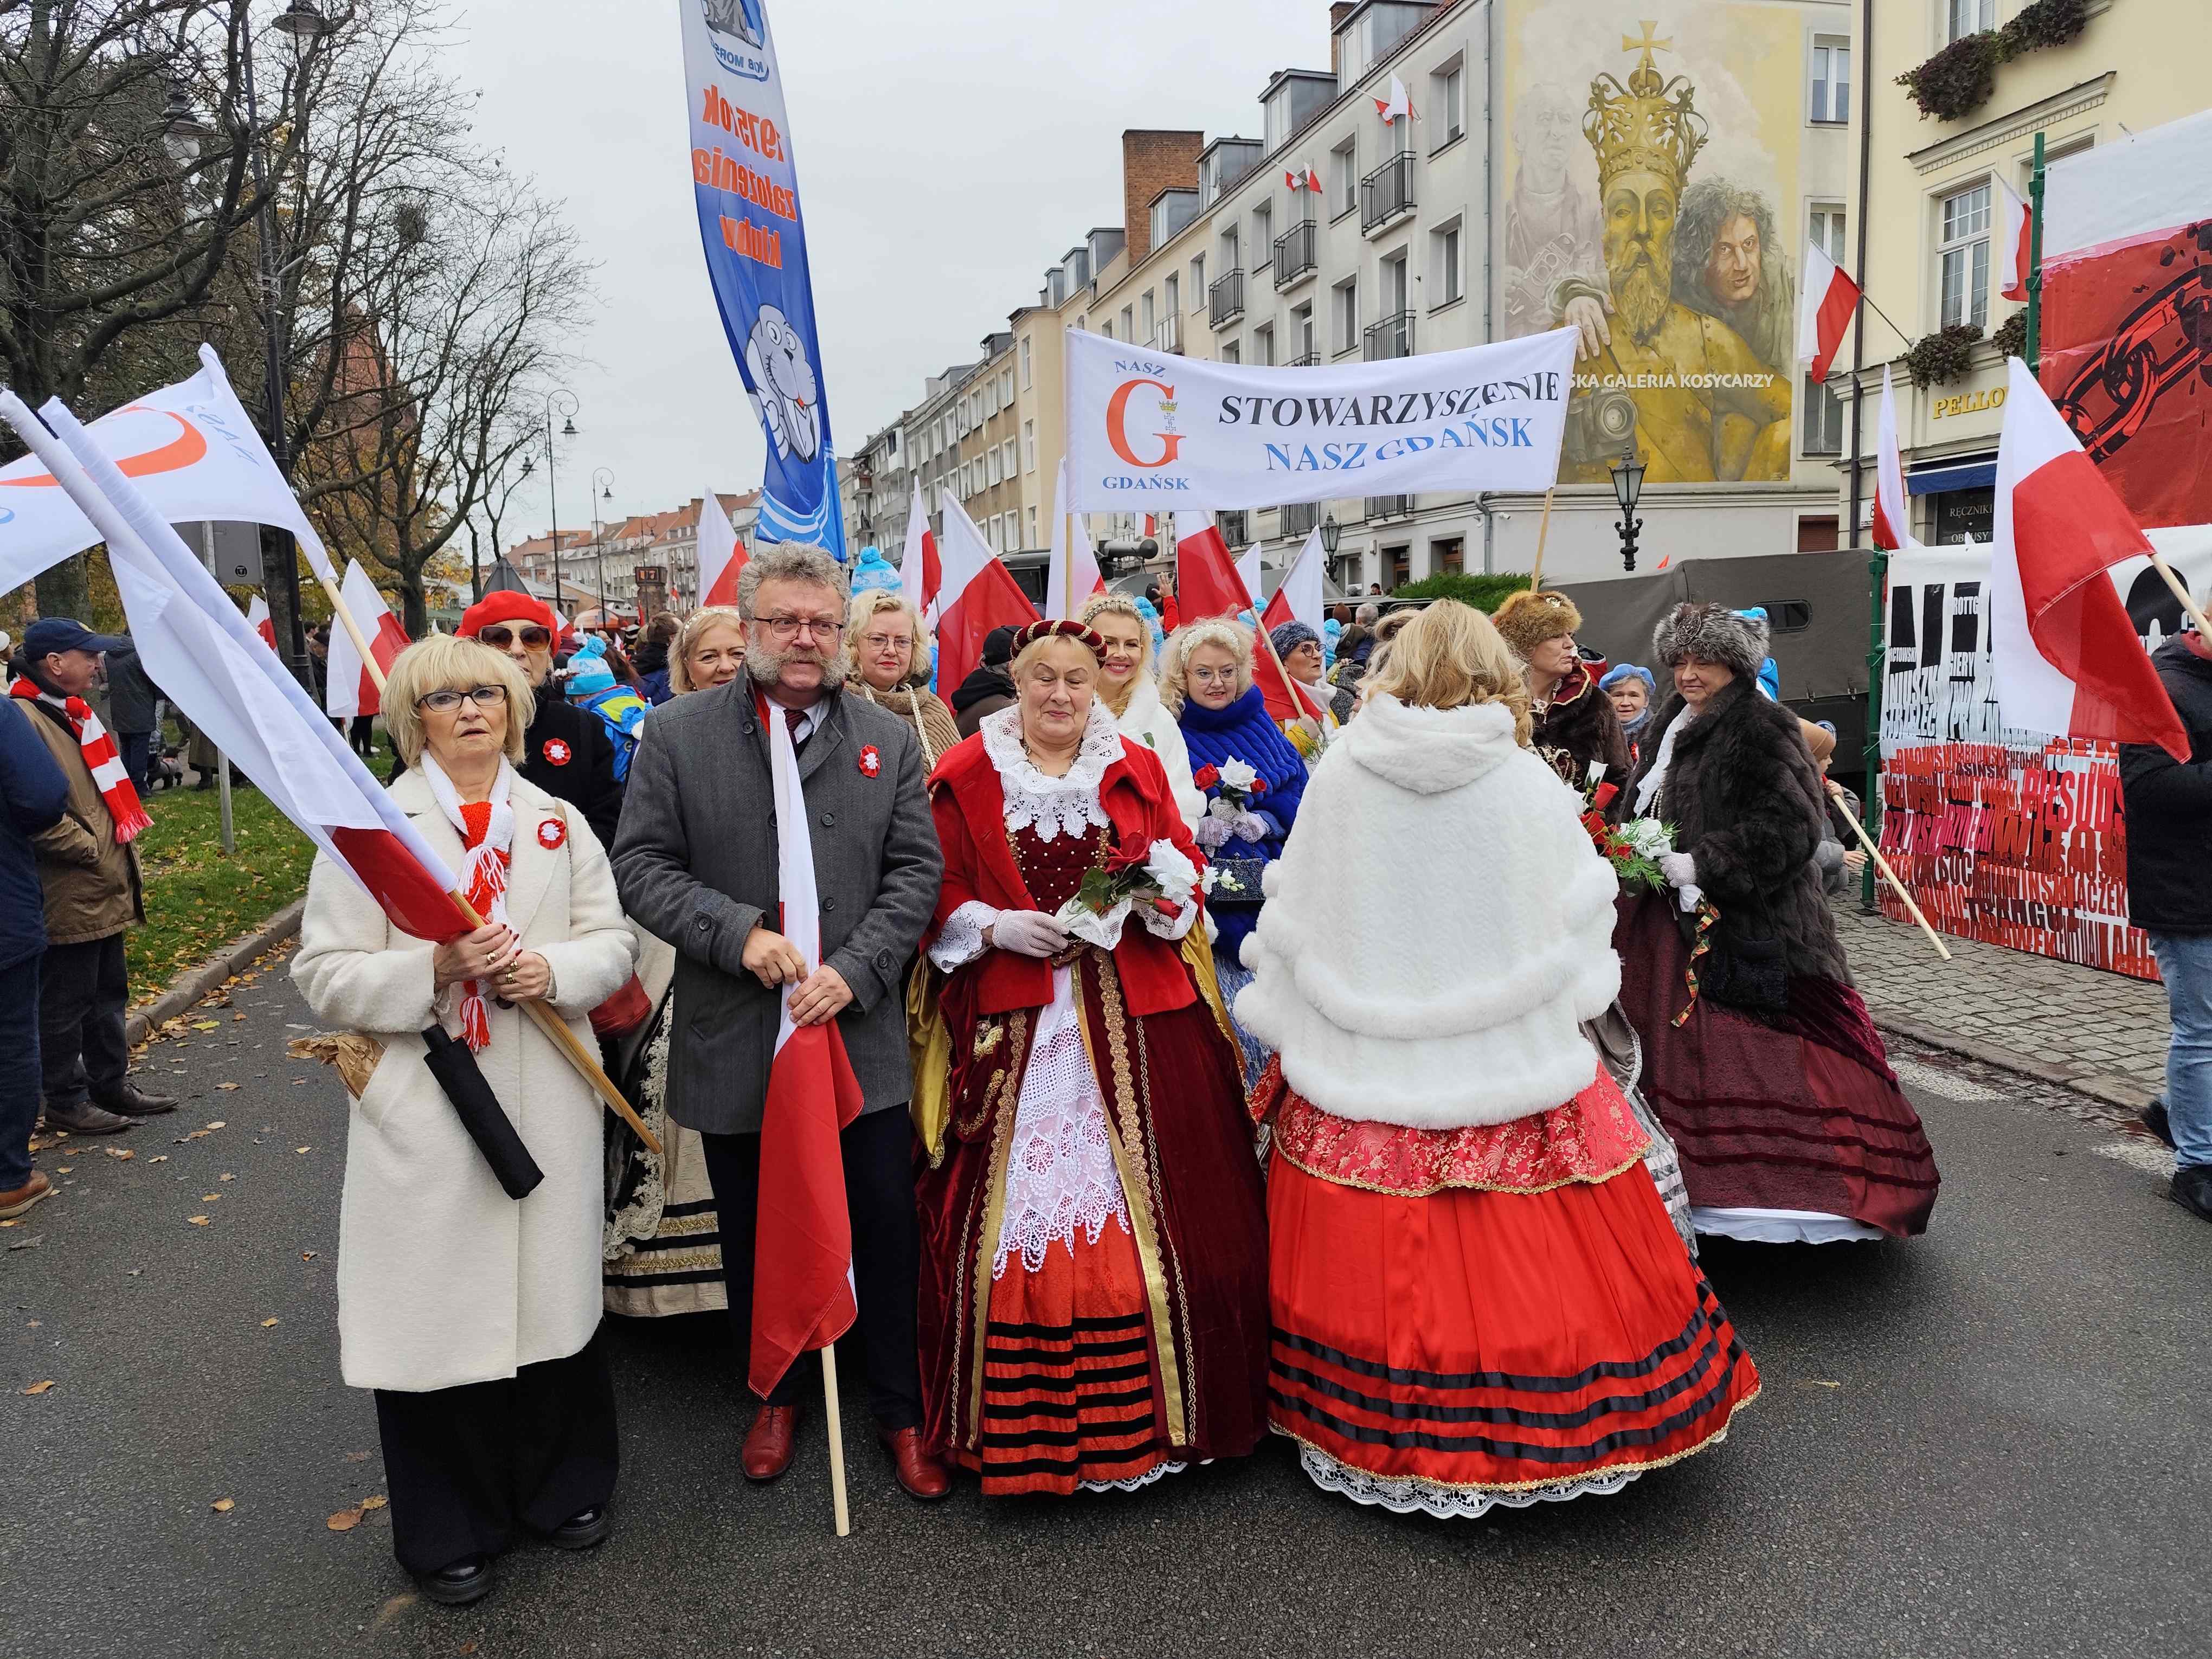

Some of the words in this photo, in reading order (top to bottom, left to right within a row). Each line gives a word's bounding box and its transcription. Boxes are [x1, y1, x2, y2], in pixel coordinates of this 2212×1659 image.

[1115, 361, 1166, 378] NASZ
[1571, 374, 1599, 388] SKA
[1603, 374, 1675, 388] GALERIA
[1680, 374, 1774, 389] KOSYCARZY
[1219, 372, 1560, 426] STOWARZYSZENIE
[1107, 379, 1186, 467] G
[1263, 442, 1367, 472] NASZ
[1376, 413, 1534, 461] GDAŃSK
[1103, 474, 1191, 490] GDAŃSK
[1950, 504, 1992, 518] RĘCZNIKI
[1952, 531, 1989, 543] OBUSY
